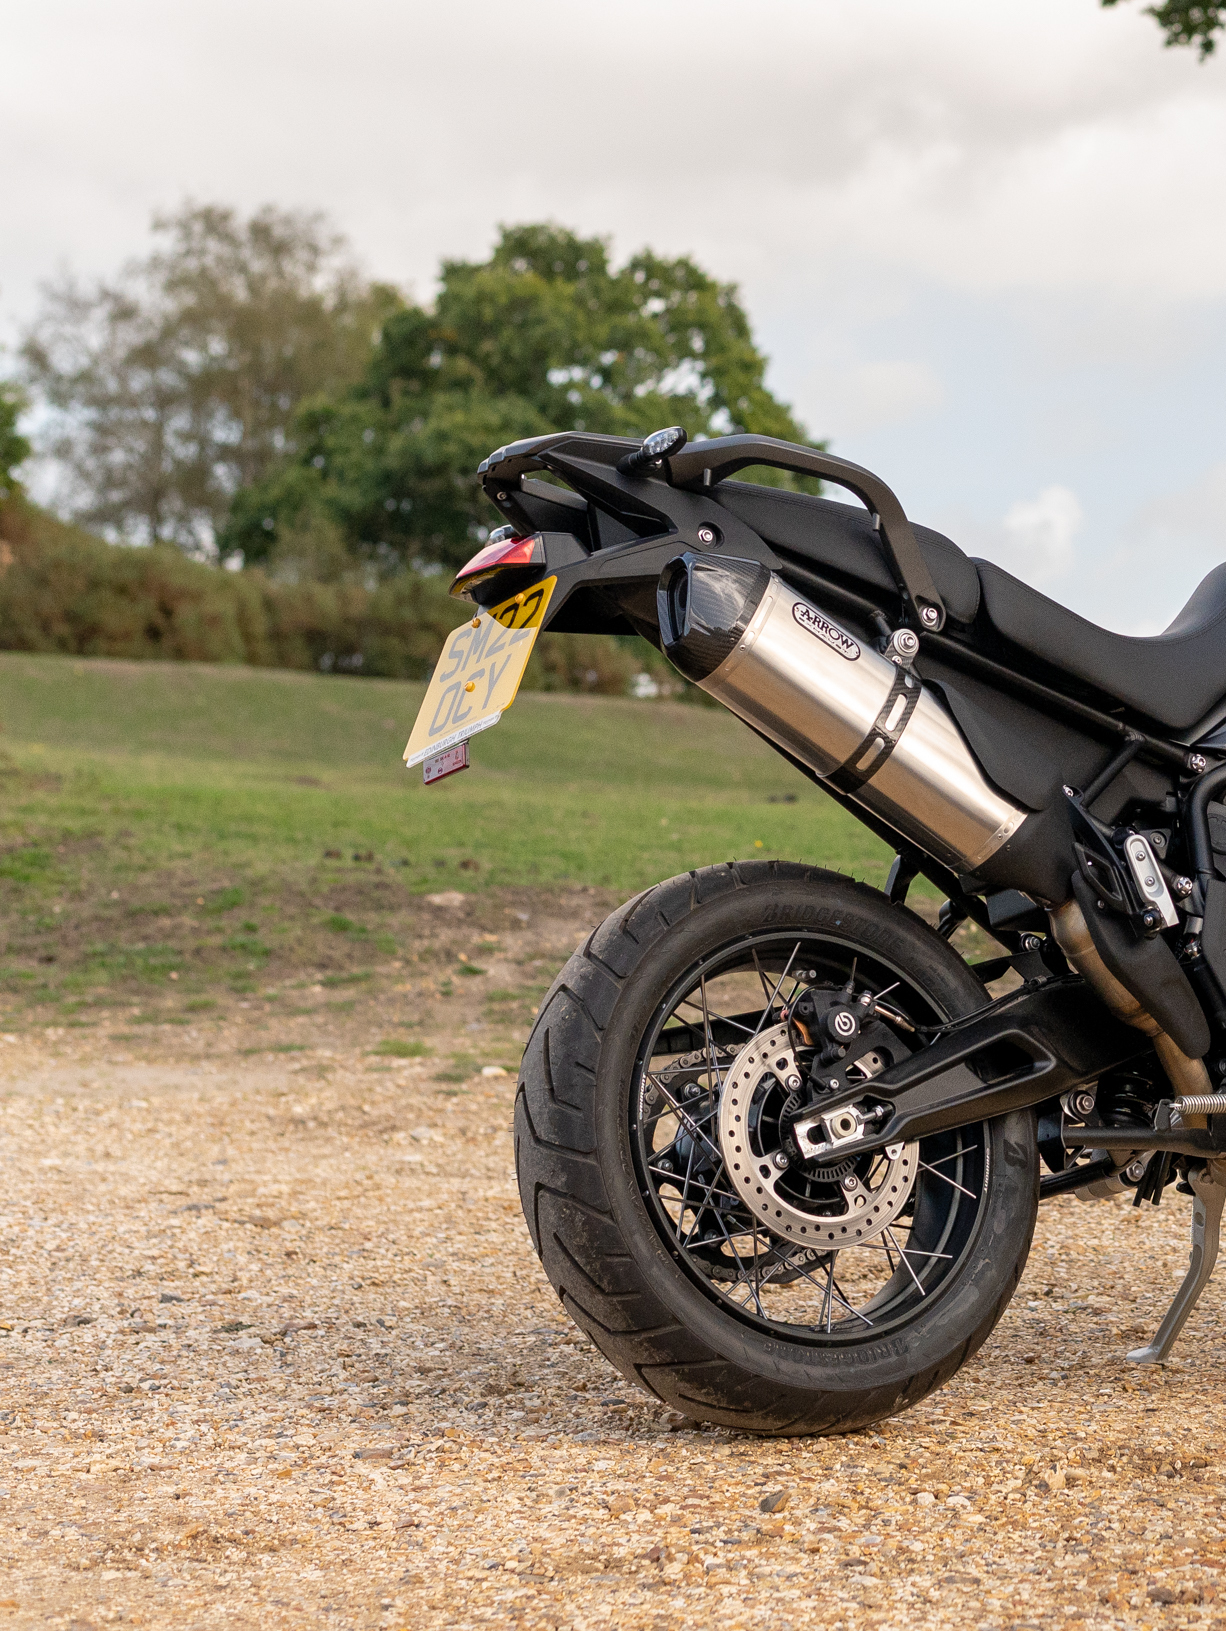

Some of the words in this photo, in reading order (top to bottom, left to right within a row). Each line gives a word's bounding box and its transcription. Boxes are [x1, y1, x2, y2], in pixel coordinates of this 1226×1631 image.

[439, 588, 545, 683] SM22
[800, 607, 855, 650] ARROW
[428, 653, 512, 737] OCY
